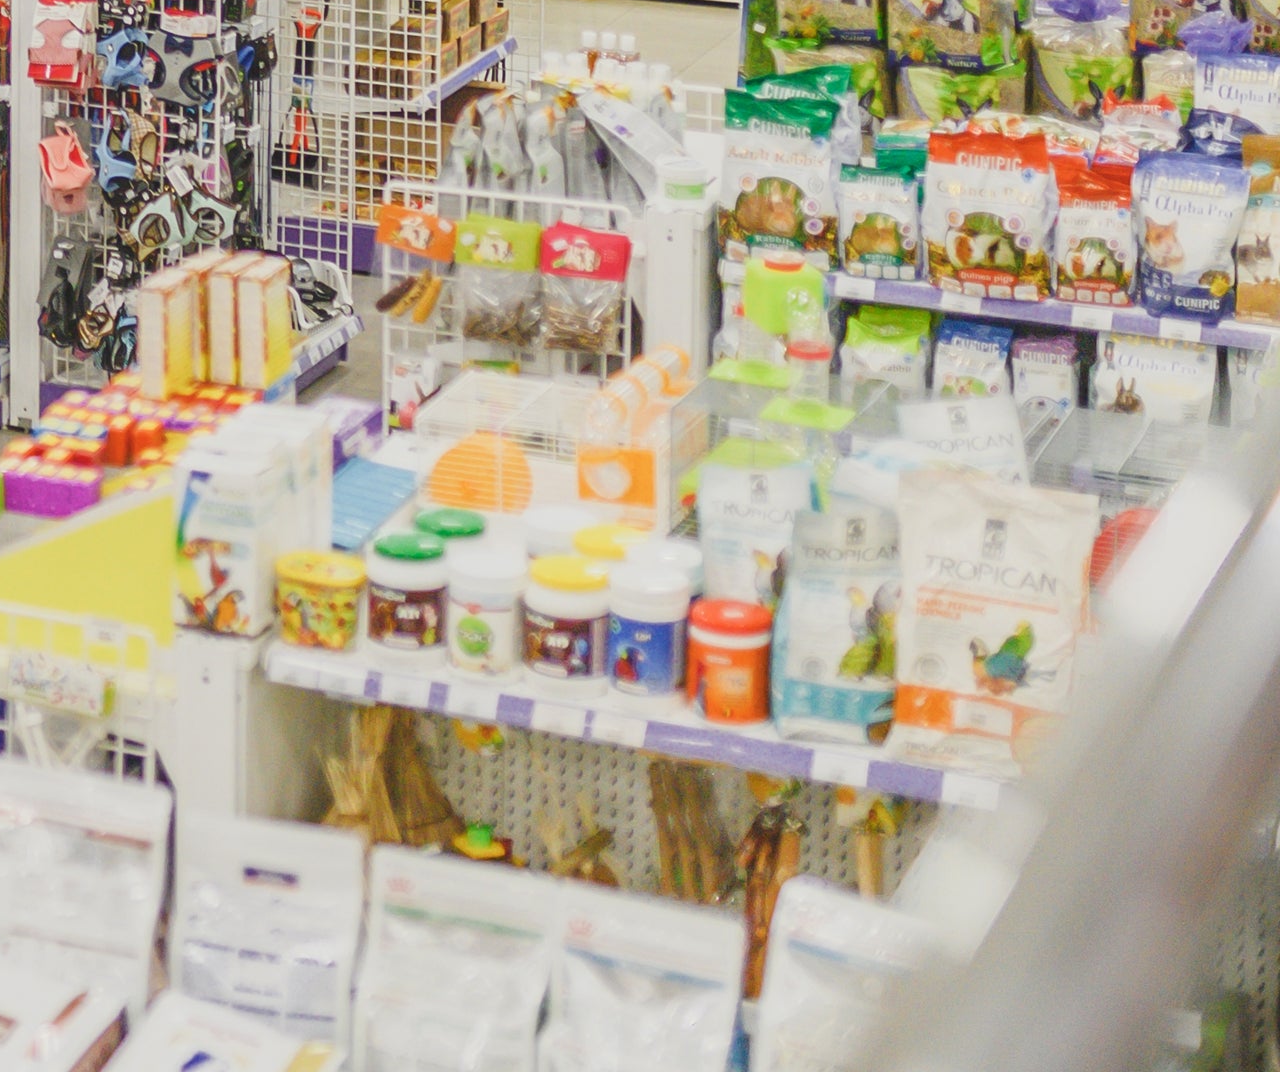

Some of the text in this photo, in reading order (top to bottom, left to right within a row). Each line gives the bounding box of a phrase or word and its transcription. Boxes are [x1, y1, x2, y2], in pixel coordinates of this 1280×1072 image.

[946, 58, 978, 69] Nature
[749, 118, 812, 140] CUNIPIC
[956, 152, 1022, 170] CUNIPIC
[1072, 198, 1119, 211] CUNIPIC
[1155, 195, 1204, 216] Alpha
[993, 274, 1014, 284] pigs
[1174, 295, 1221, 311] CUNIPIC
[1020, 351, 1069, 366] CUNIPIC
[925, 553, 1058, 597] TROPICAN
